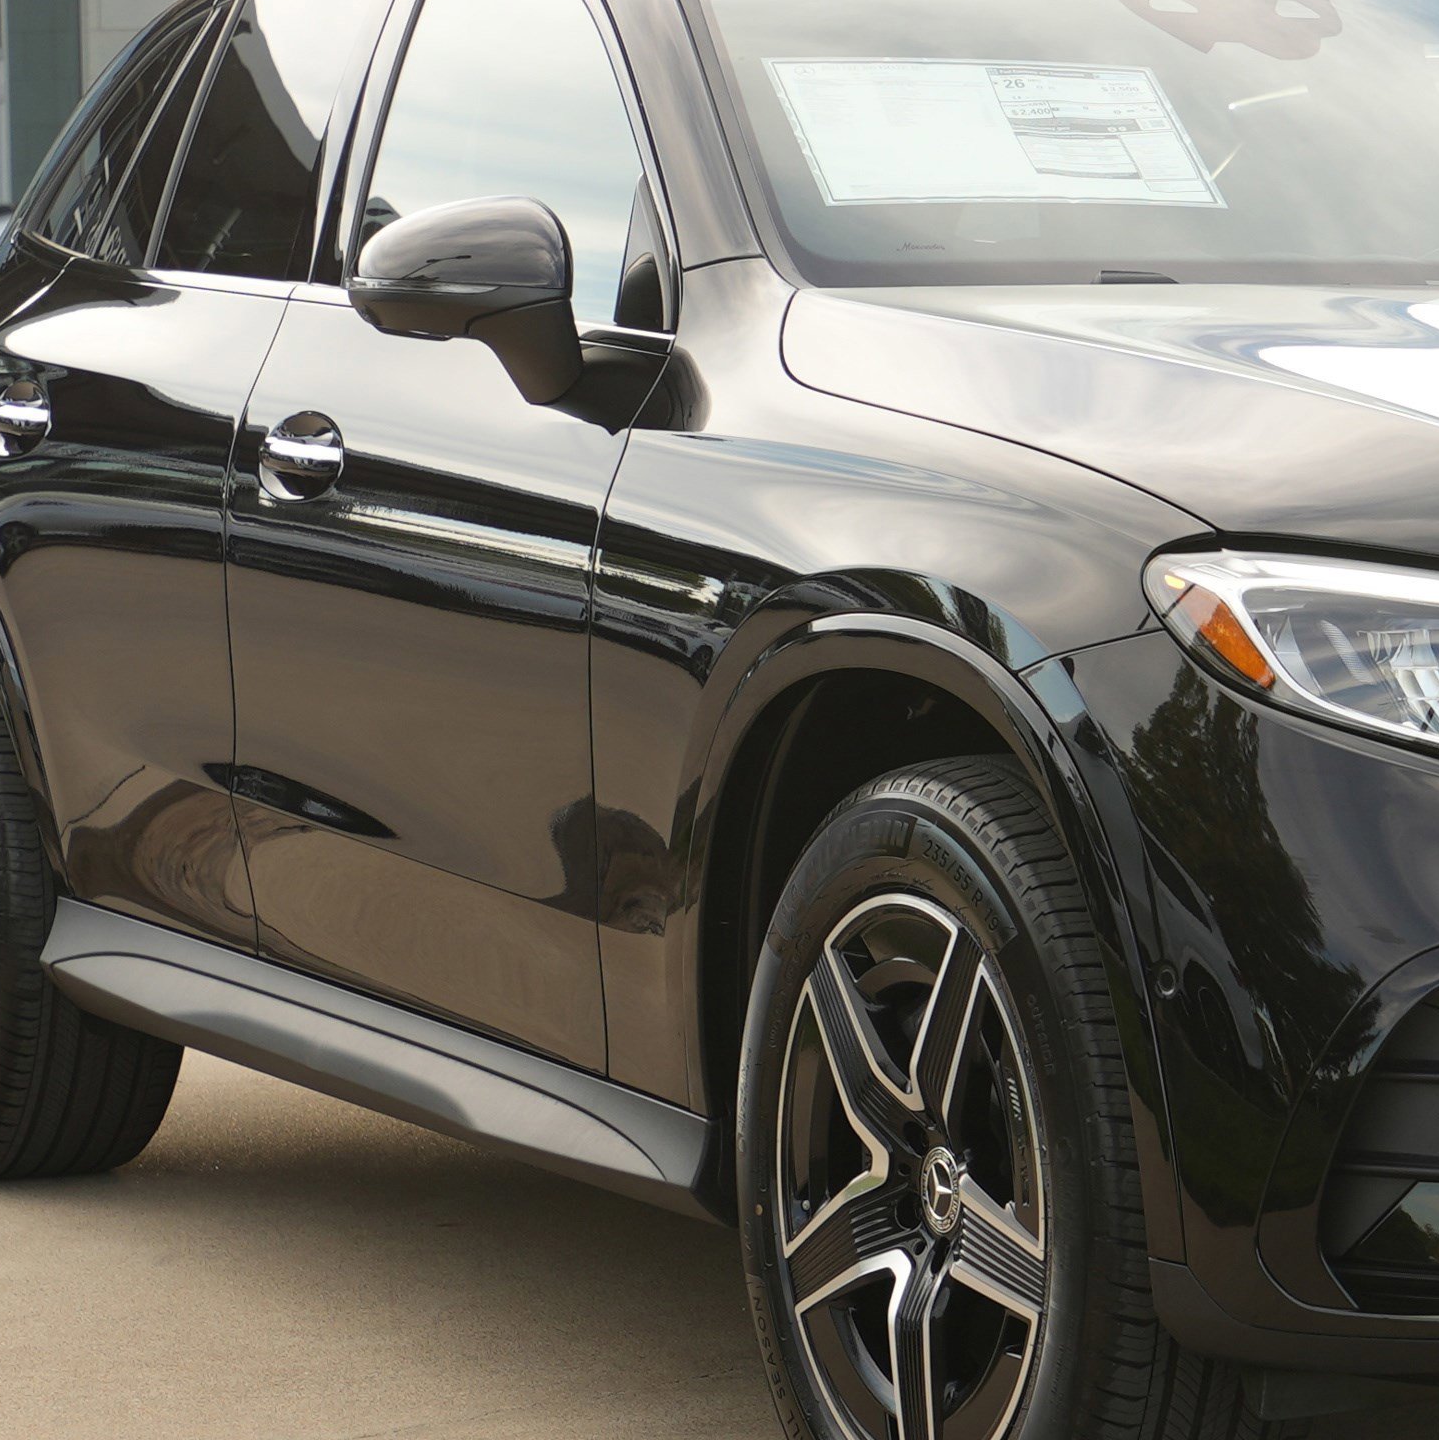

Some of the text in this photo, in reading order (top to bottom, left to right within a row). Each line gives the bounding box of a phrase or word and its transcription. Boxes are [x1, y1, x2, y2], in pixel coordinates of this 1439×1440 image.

[923, 838, 1001, 932] 235/55 R 19
[752, 1295, 785, 1400] SEASON
